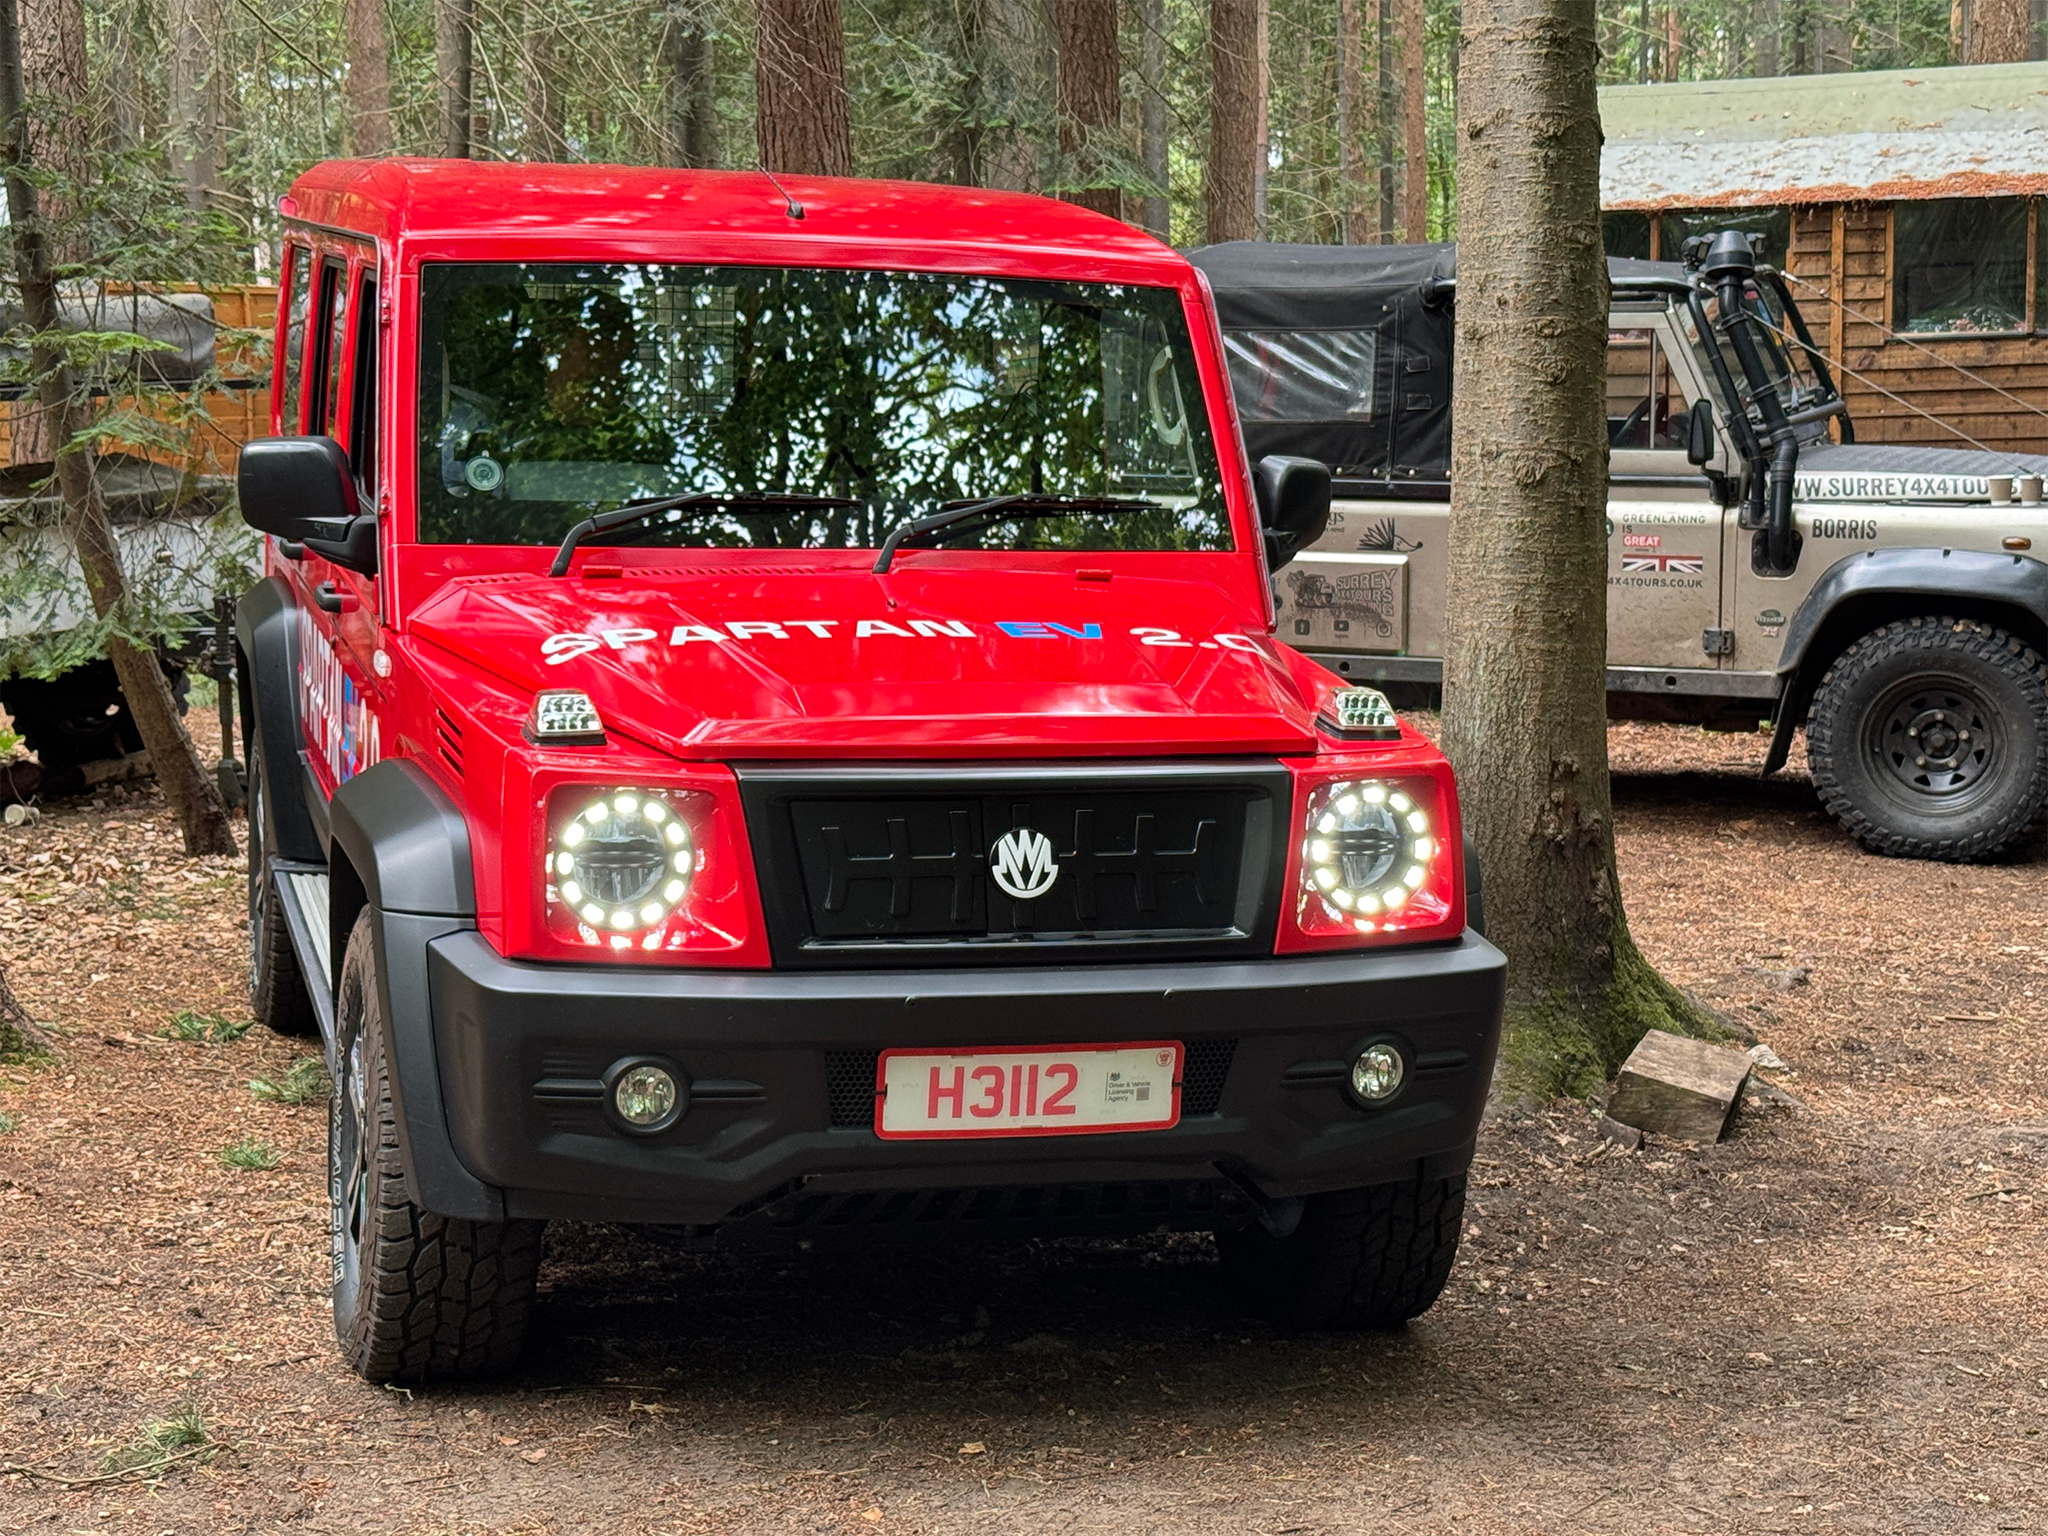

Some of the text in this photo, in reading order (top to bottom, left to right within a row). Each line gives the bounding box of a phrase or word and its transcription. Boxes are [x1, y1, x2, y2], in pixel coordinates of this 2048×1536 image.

[1622, 513, 1706, 525] GREENLANING
[1622, 525, 1633, 534] IS
[1812, 518, 1877, 540] BORRIS
[1623, 536, 1661, 547] GREAT
[1336, 568, 1398, 590] SURREY
[540, 619, 976, 666] SPARTAN
[993, 620, 1103, 639] EV
[926, 1062, 1079, 1119] H3112
[1108, 1095, 1129, 1103] Agency
